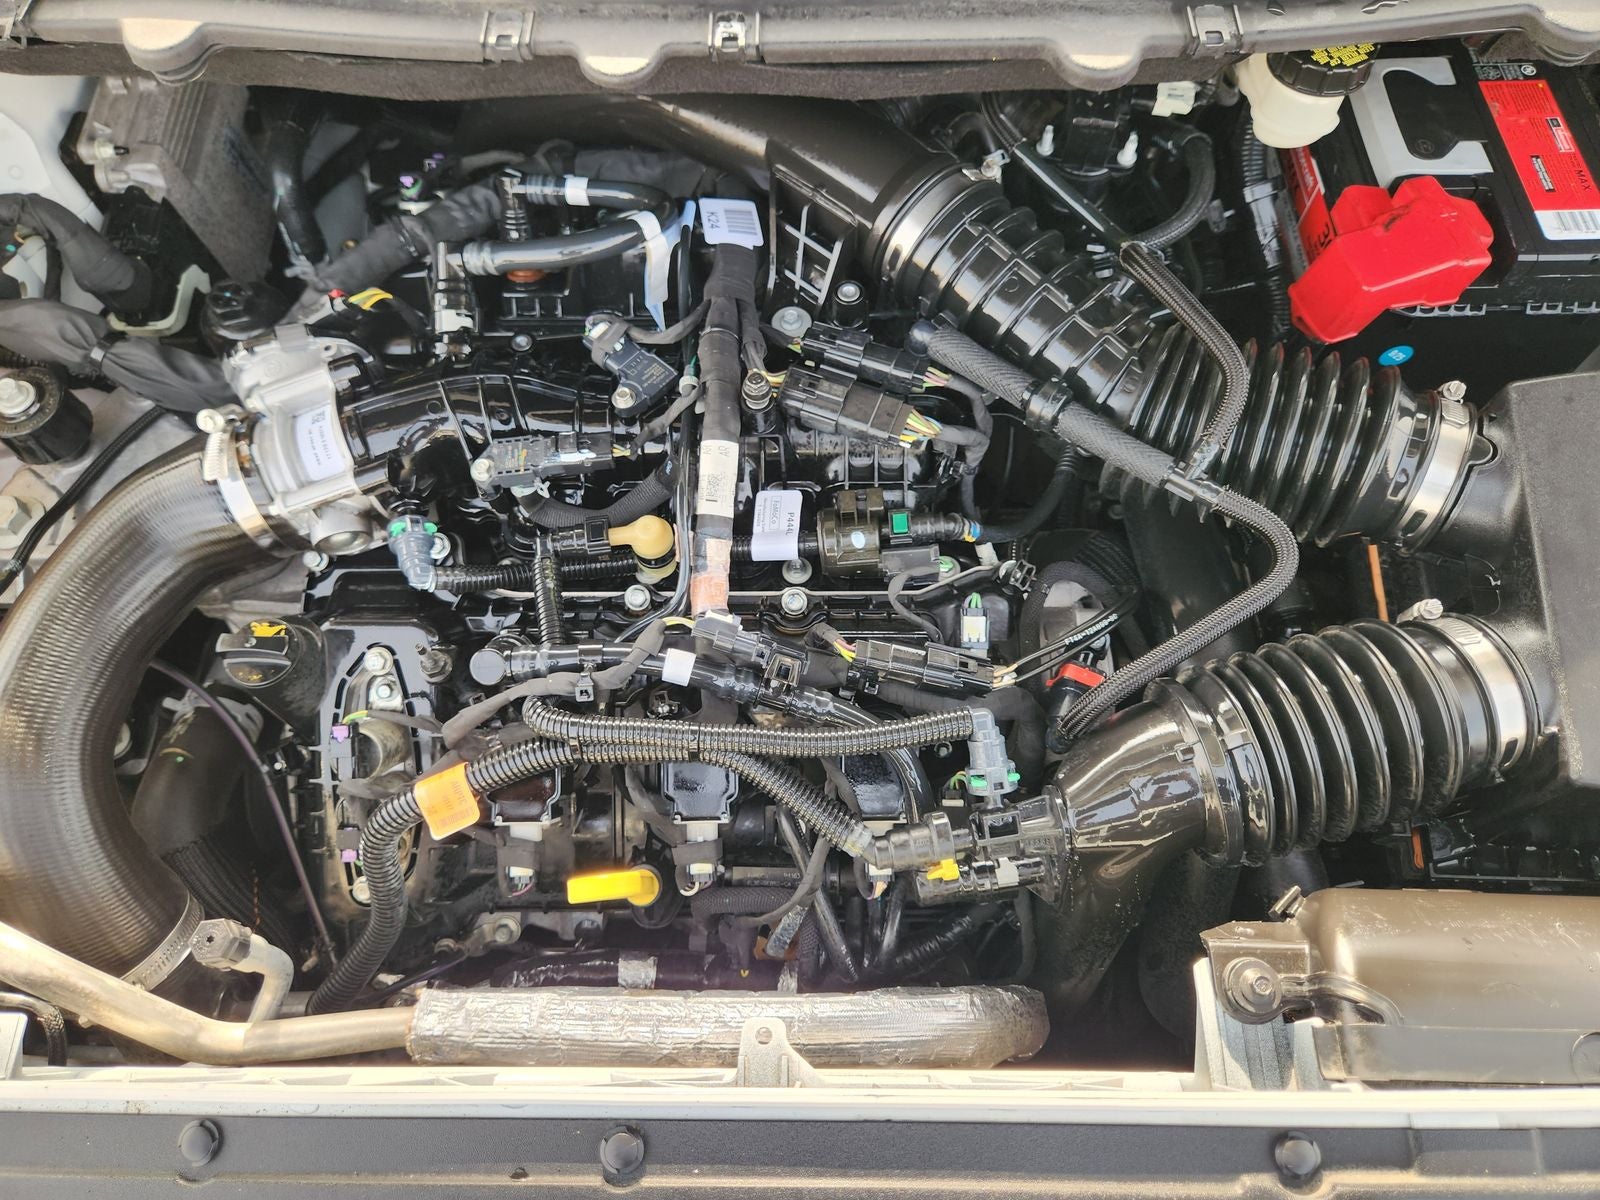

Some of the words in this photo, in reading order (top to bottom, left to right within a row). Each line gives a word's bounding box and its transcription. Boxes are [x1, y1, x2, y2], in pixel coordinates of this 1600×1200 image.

[1574, 169, 1592, 191] MAX
[706, 211, 720, 229] K24
[785, 512, 795, 536] P444L
